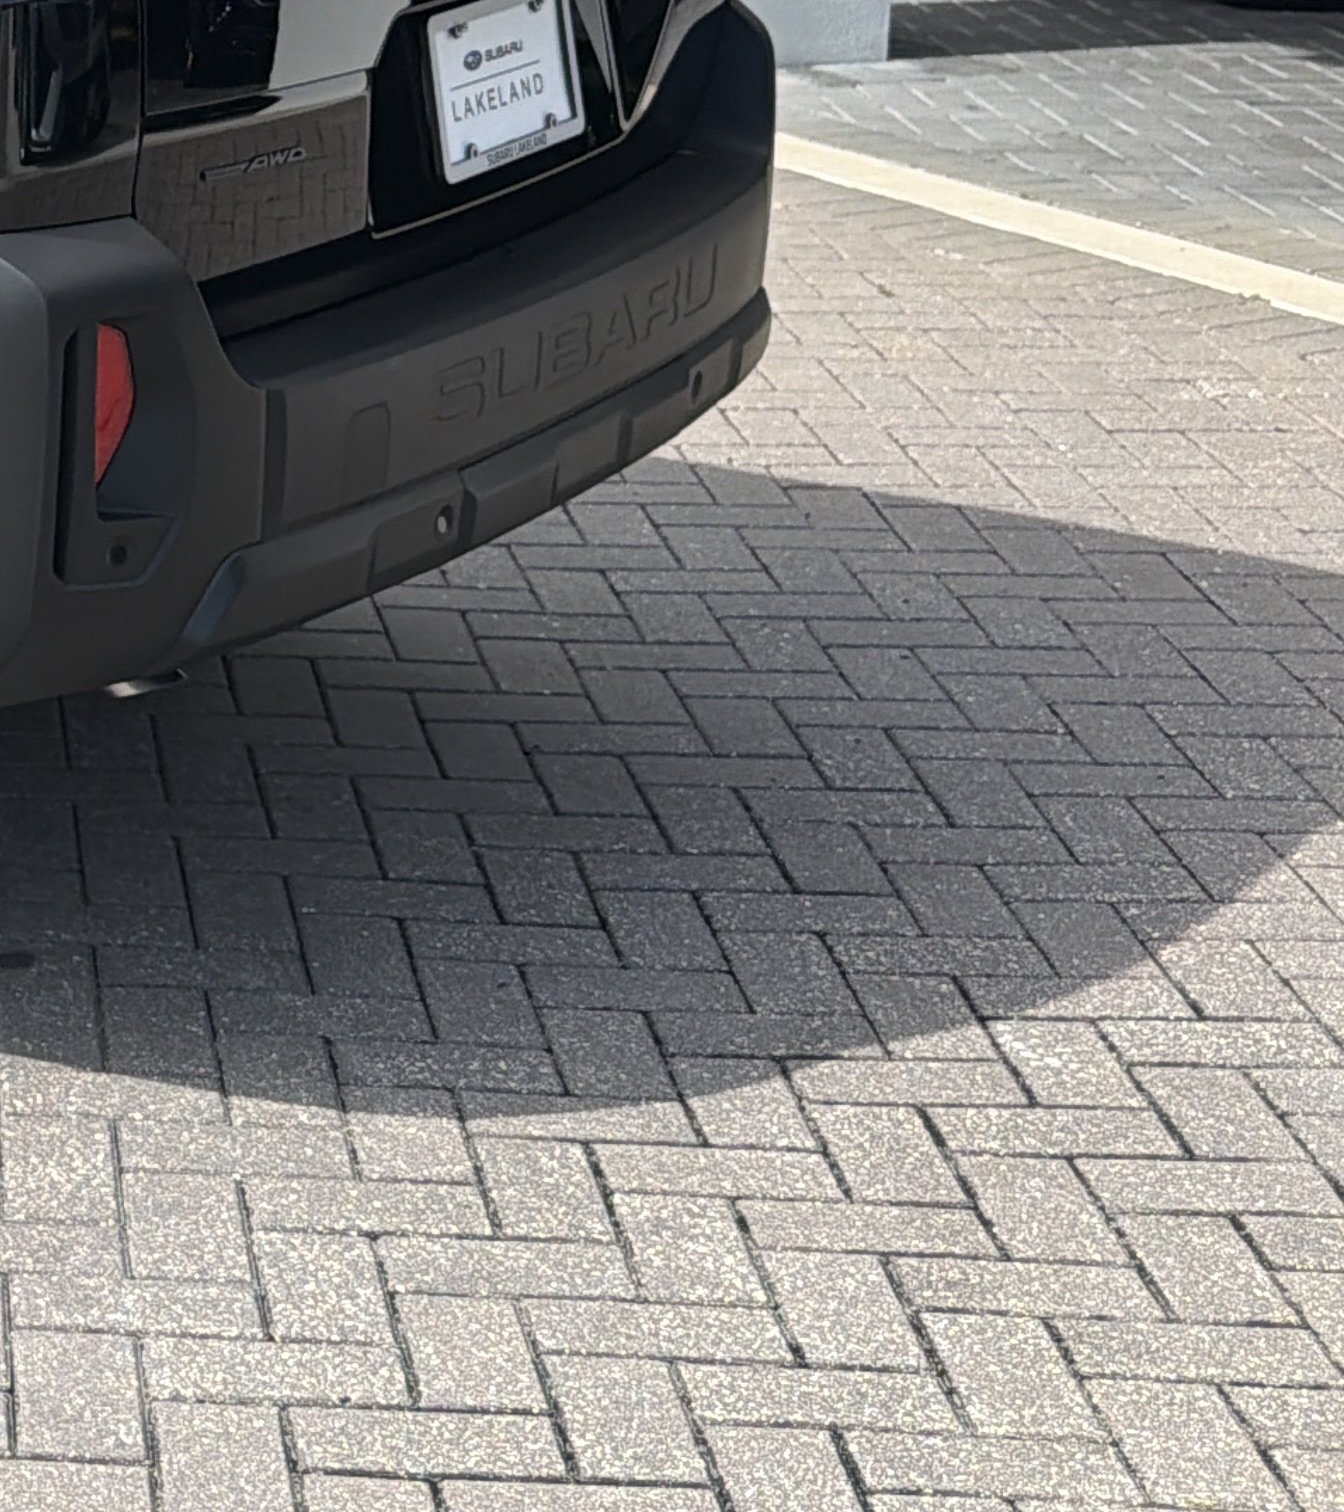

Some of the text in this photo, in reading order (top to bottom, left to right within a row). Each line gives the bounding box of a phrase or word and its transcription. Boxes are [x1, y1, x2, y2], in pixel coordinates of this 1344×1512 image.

[484, 40, 523, 63] SUBARU
[450, 73, 545, 123] LAKELAND
[246, 146, 308, 173] AWD
[487, 146, 514, 167] SUBARU
[432, 242, 718, 423] SUBARU
